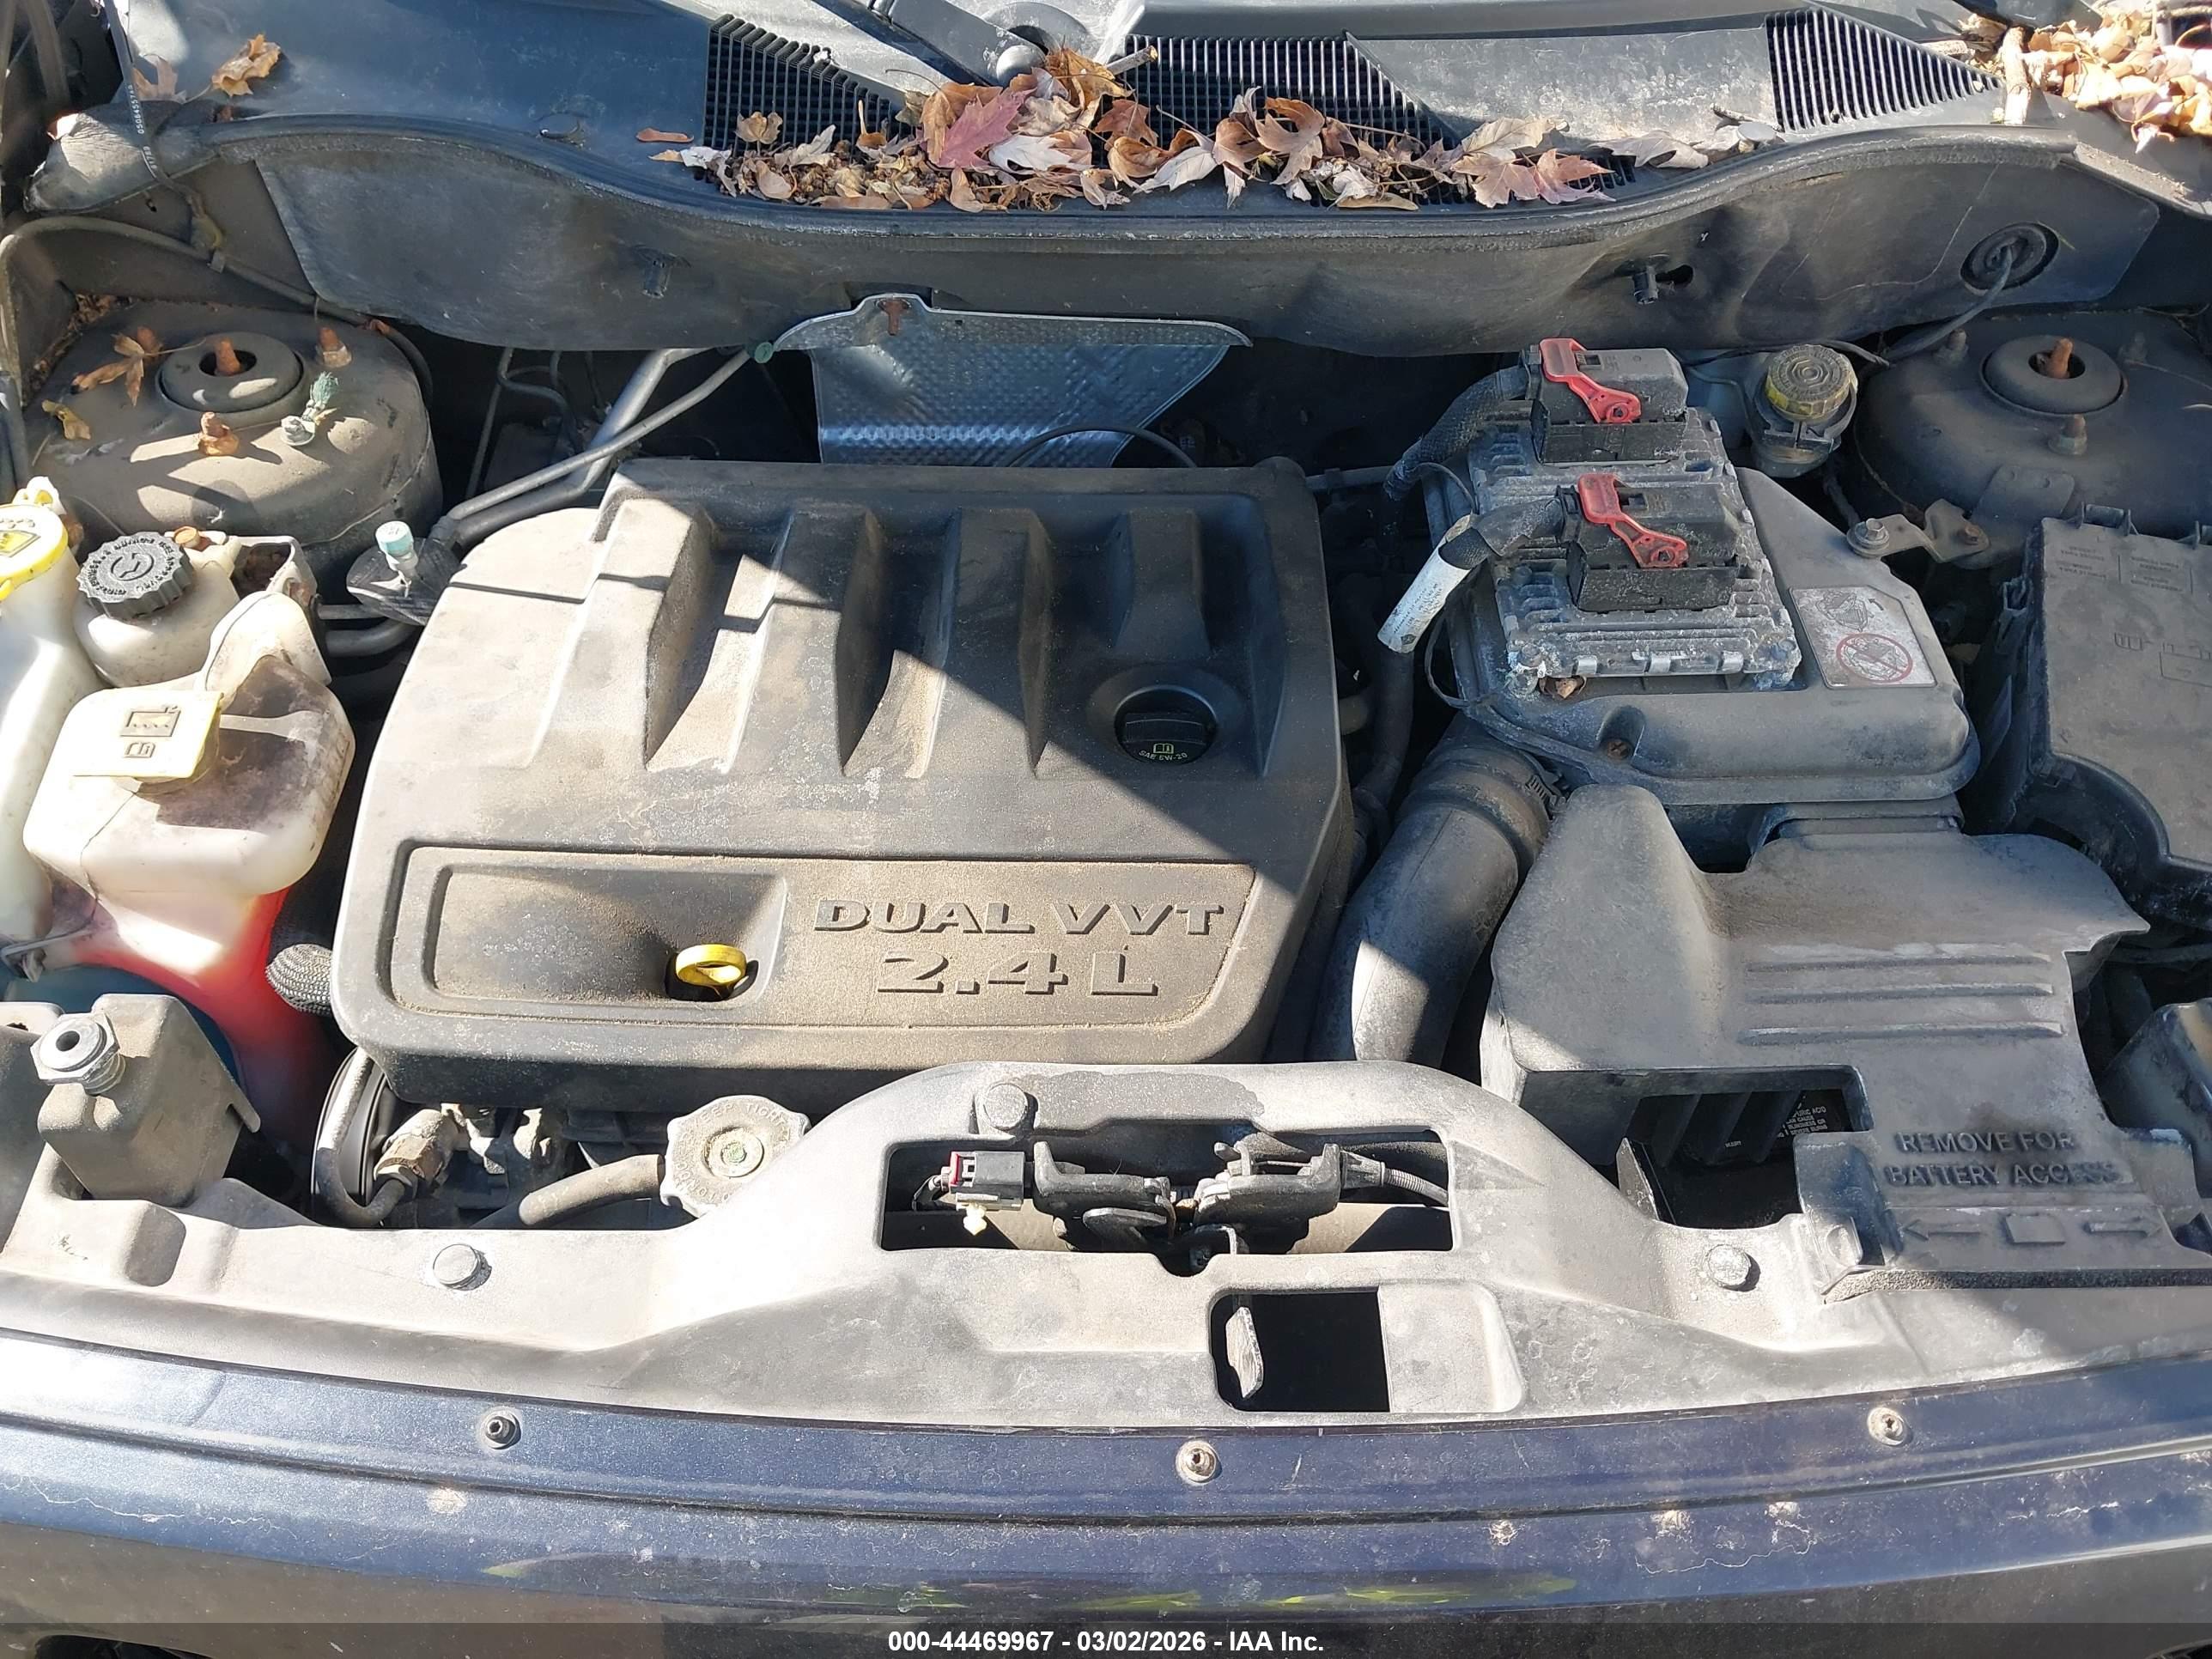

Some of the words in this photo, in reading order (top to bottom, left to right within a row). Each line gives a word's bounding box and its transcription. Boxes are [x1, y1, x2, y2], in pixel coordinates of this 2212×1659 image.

[1139, 750, 1156, 760] SAE
[814, 899, 1036, 934] DUAL
[1053, 903, 1224, 936] VVT
[745, 1103, 787, 1127] TIGHT
[1894, 1131, 2014, 1153] REMOVE
[2019, 1130, 2076, 1152] FOR
[1884, 1164, 2001, 1186] BATTERY
[2011, 1162, 2120, 1185] ACCESS
